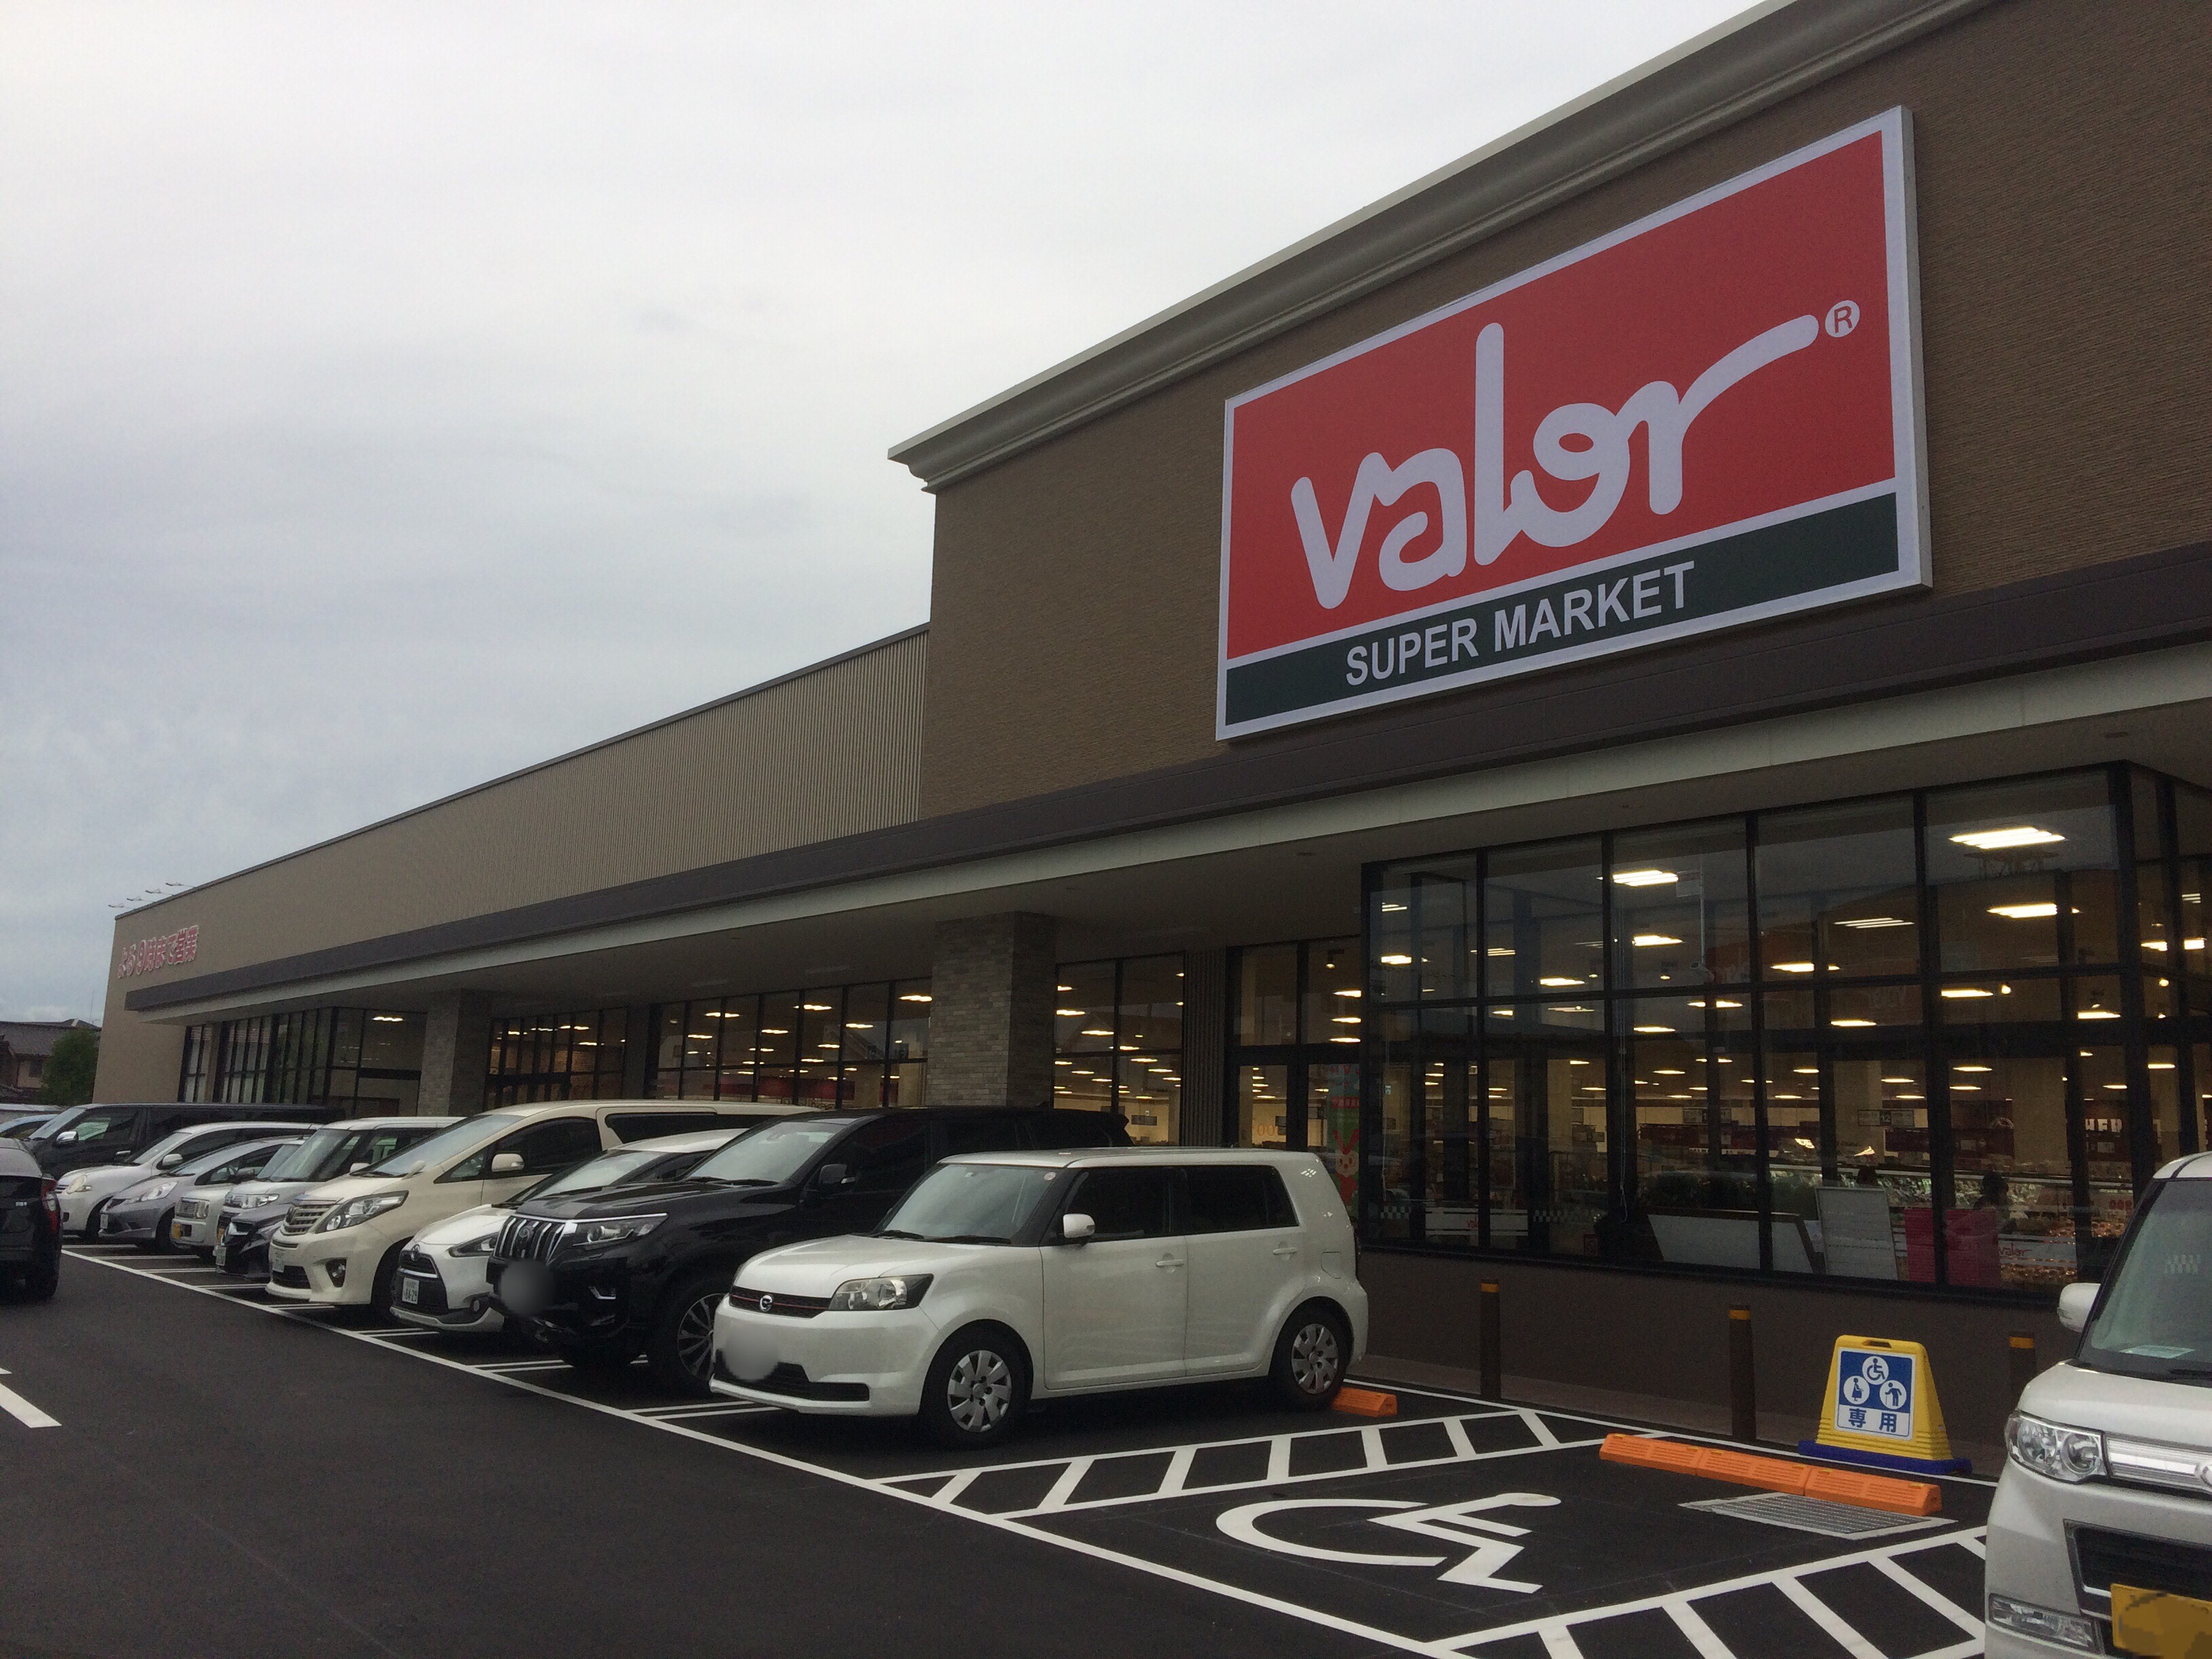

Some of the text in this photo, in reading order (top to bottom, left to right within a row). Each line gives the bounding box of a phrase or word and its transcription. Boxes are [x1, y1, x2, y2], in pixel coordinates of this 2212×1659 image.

[1291, 314, 1820, 609] valor
[1346, 560, 1694, 687] SUPER MARKET
[1848, 1408, 1898, 1433] 専用
